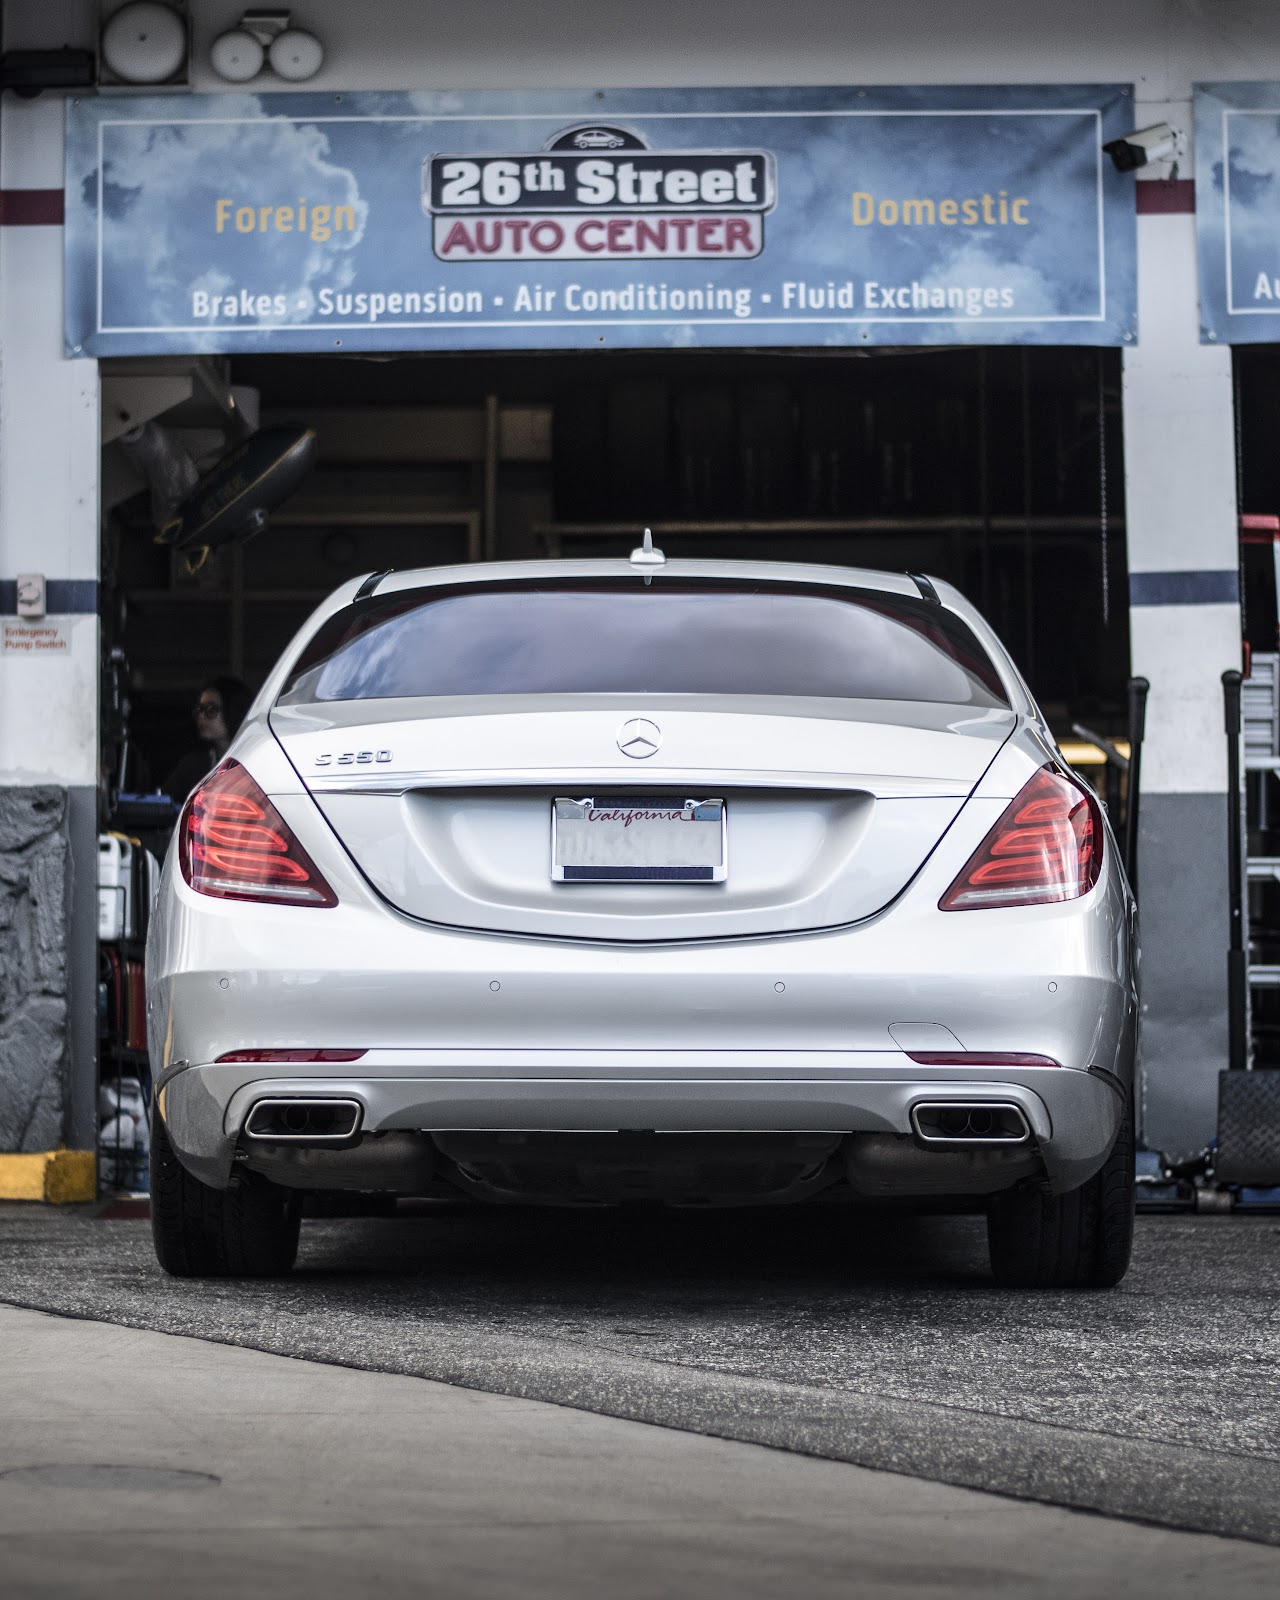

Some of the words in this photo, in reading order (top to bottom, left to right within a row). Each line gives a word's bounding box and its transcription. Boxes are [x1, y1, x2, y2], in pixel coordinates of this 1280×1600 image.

[442, 160, 566, 206] 26th
[575, 160, 758, 205] Street
[215, 198, 355, 242] Foreign
[852, 190, 1030, 226] Domestic
[441, 219, 566, 255] AUTO
[575, 218, 755, 253] CENTER
[192, 289, 287, 318] Brakes
[318, 286, 483, 322] Suspension
[513, 284, 556, 312] Air
[565, 283, 752, 318] Conditioning
[782, 281, 854, 309] Fluid
[864, 281, 1015, 316] Exchanges
[5, 627, 58, 639] Emergency
[5, 640, 33, 651] Pump
[35, 640, 67, 649] Switch
[315, 754, 332, 766] S
[337, 750, 393, 764] 550
[588, 809, 691, 827] California
